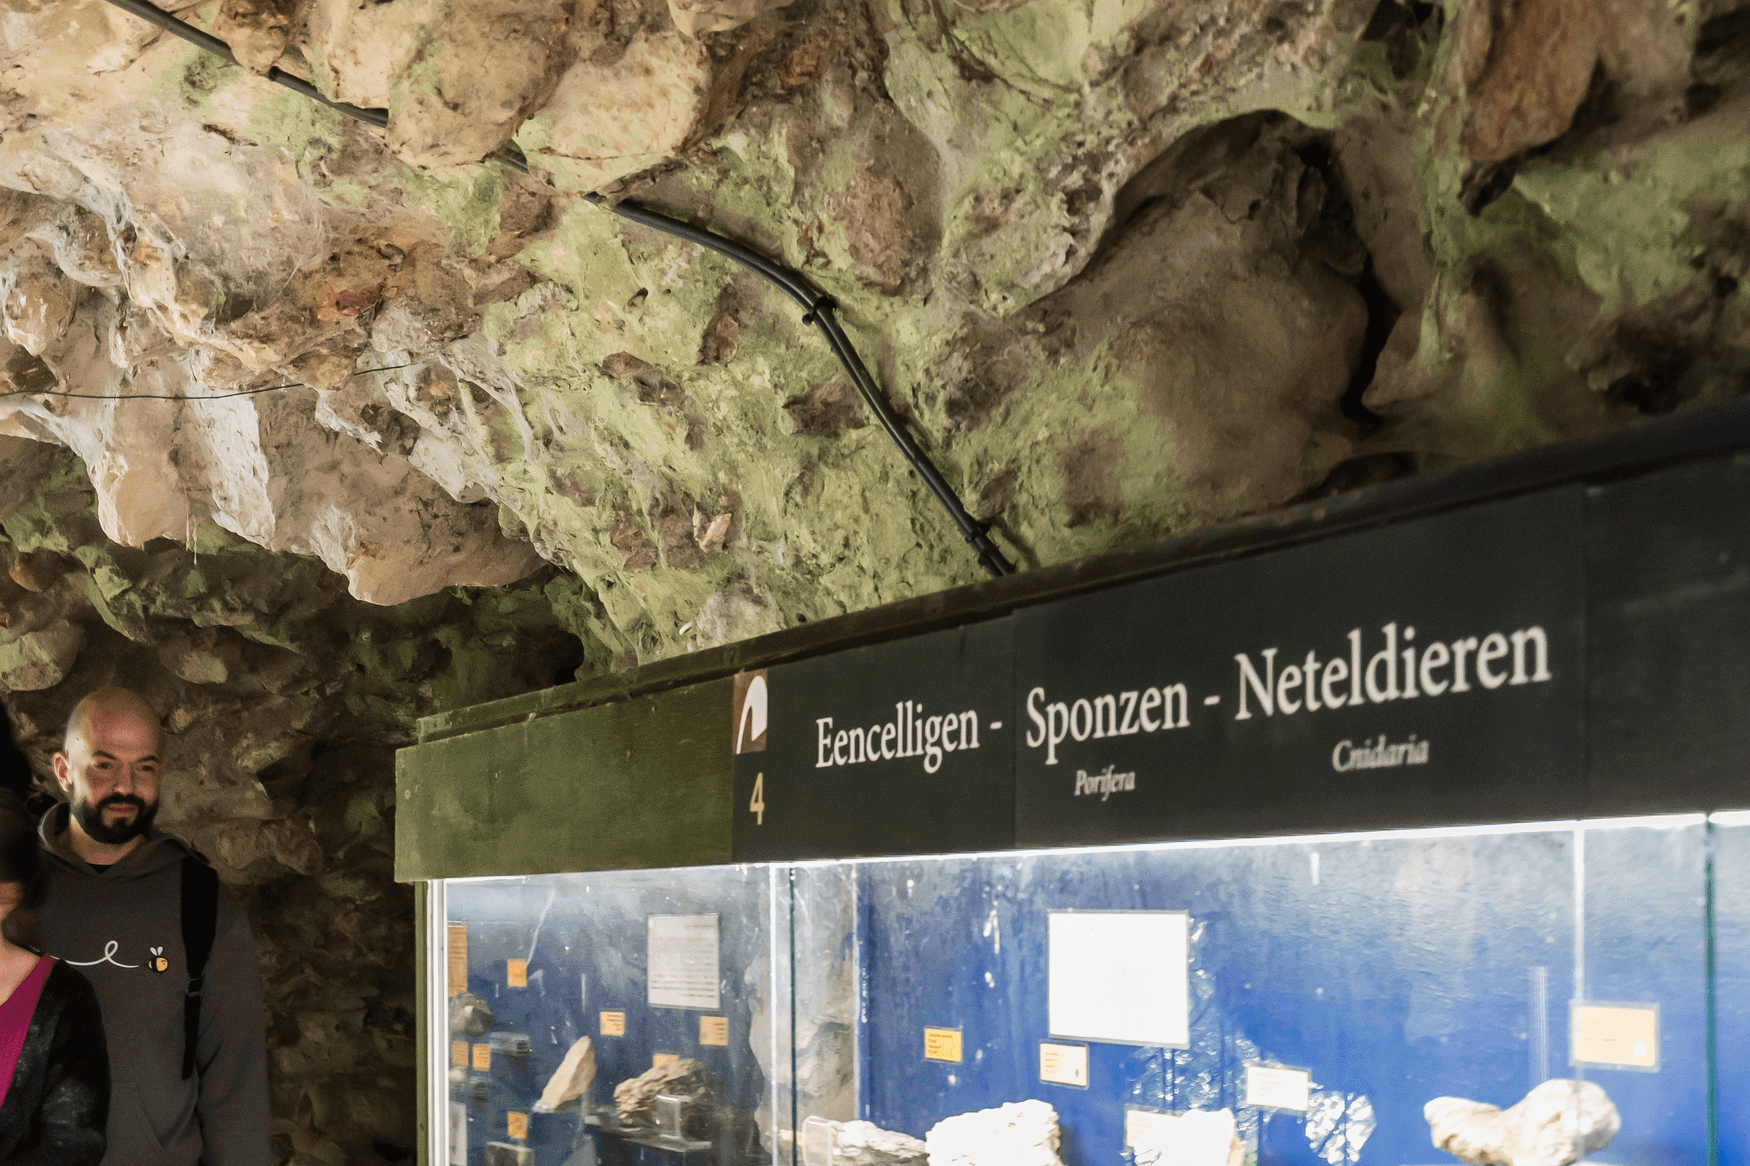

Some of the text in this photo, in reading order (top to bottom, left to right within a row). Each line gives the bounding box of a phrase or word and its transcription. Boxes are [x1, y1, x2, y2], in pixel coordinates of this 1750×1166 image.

[814, 699, 981, 773] Eencelligen
[1025, 681, 1191, 765] Sponzen
[1234, 622, 1552, 721] Neteldieren
[1332, 733, 1430, 774] Cnidaria
[749, 771, 766, 827] 4
[1073, 763, 1137, 803] Porifera
